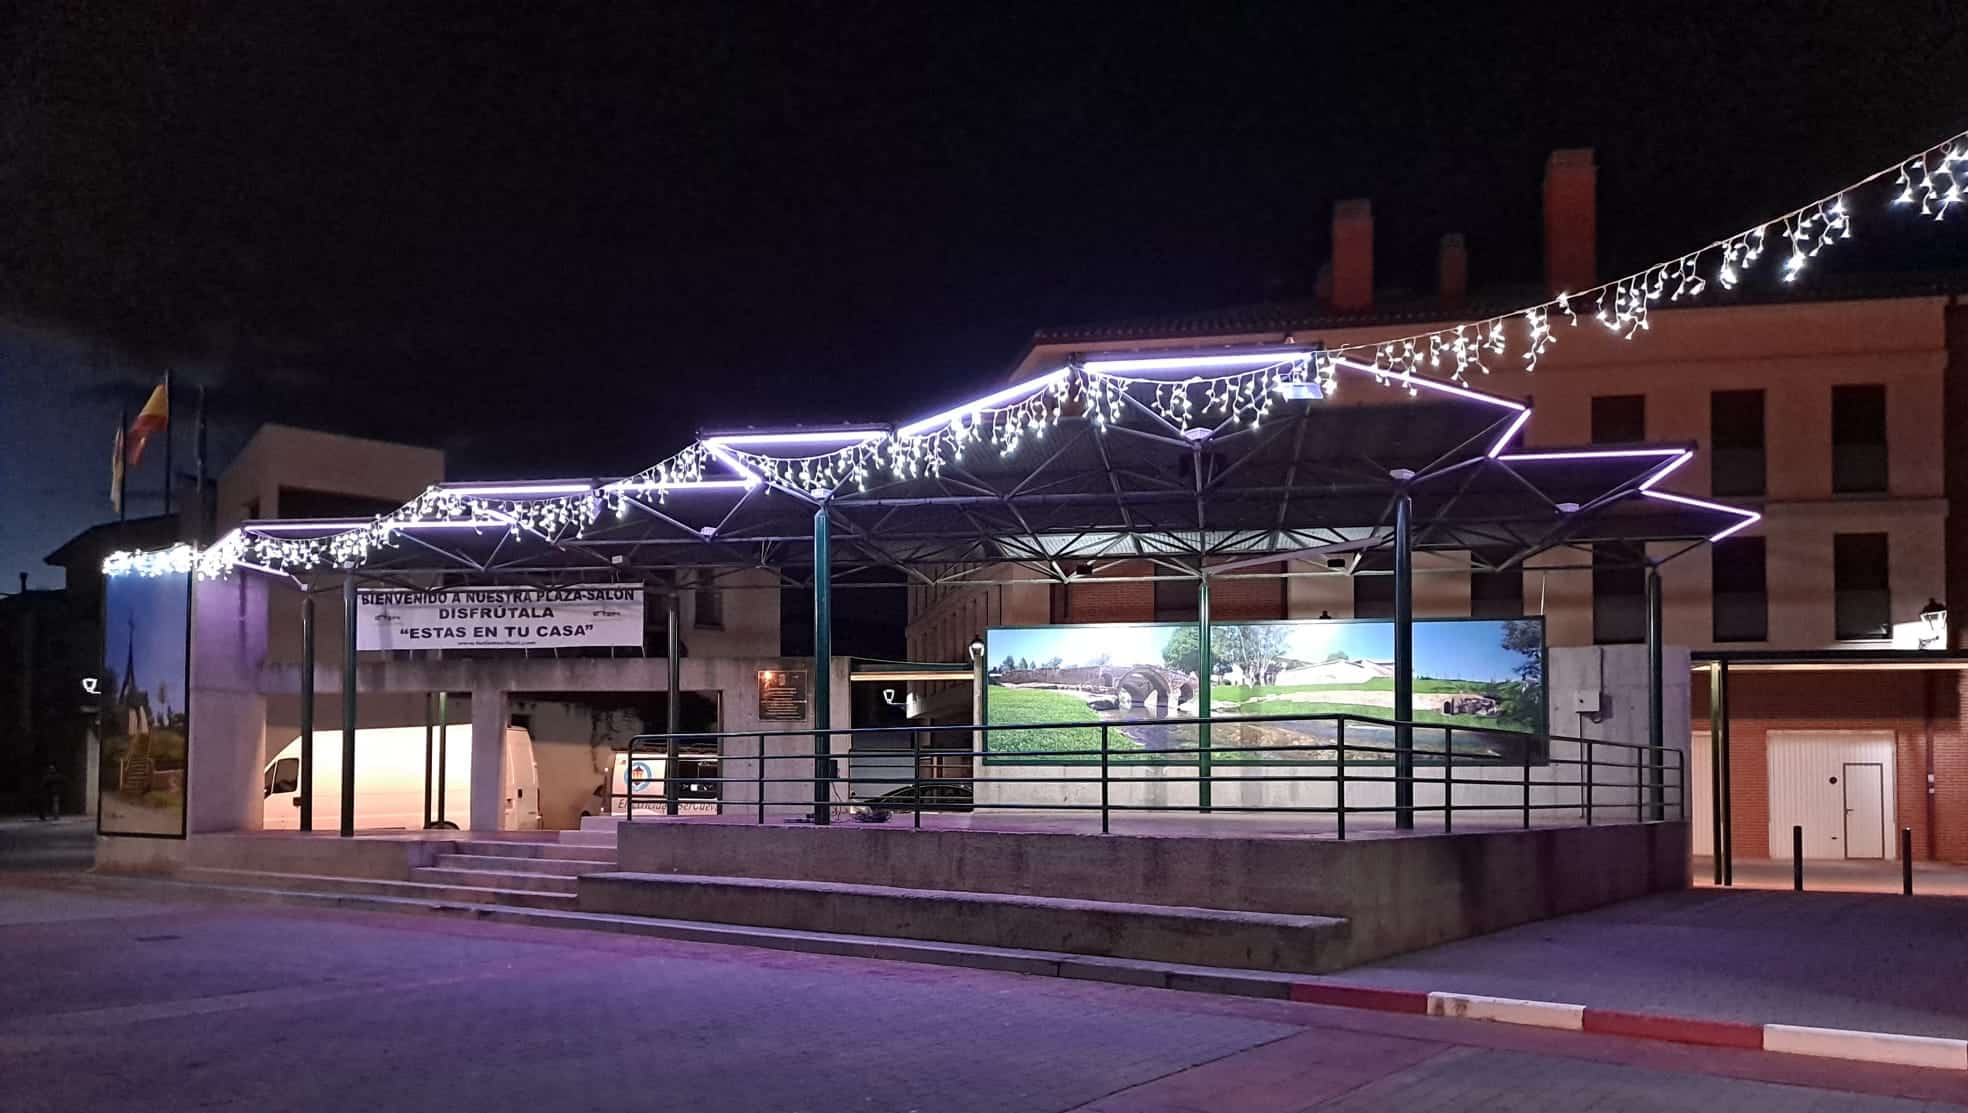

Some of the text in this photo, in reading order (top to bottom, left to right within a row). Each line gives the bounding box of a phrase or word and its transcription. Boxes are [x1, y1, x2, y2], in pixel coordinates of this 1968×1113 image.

[361, 592, 448, 605] BIENVENIDO
[451, 592, 461, 604] A
[465, 591, 532, 604] NUESTRA
[438, 604, 555, 621] DISFRÚTALA
[399, 624, 594, 640] “ESTAS EN TU CASA”
